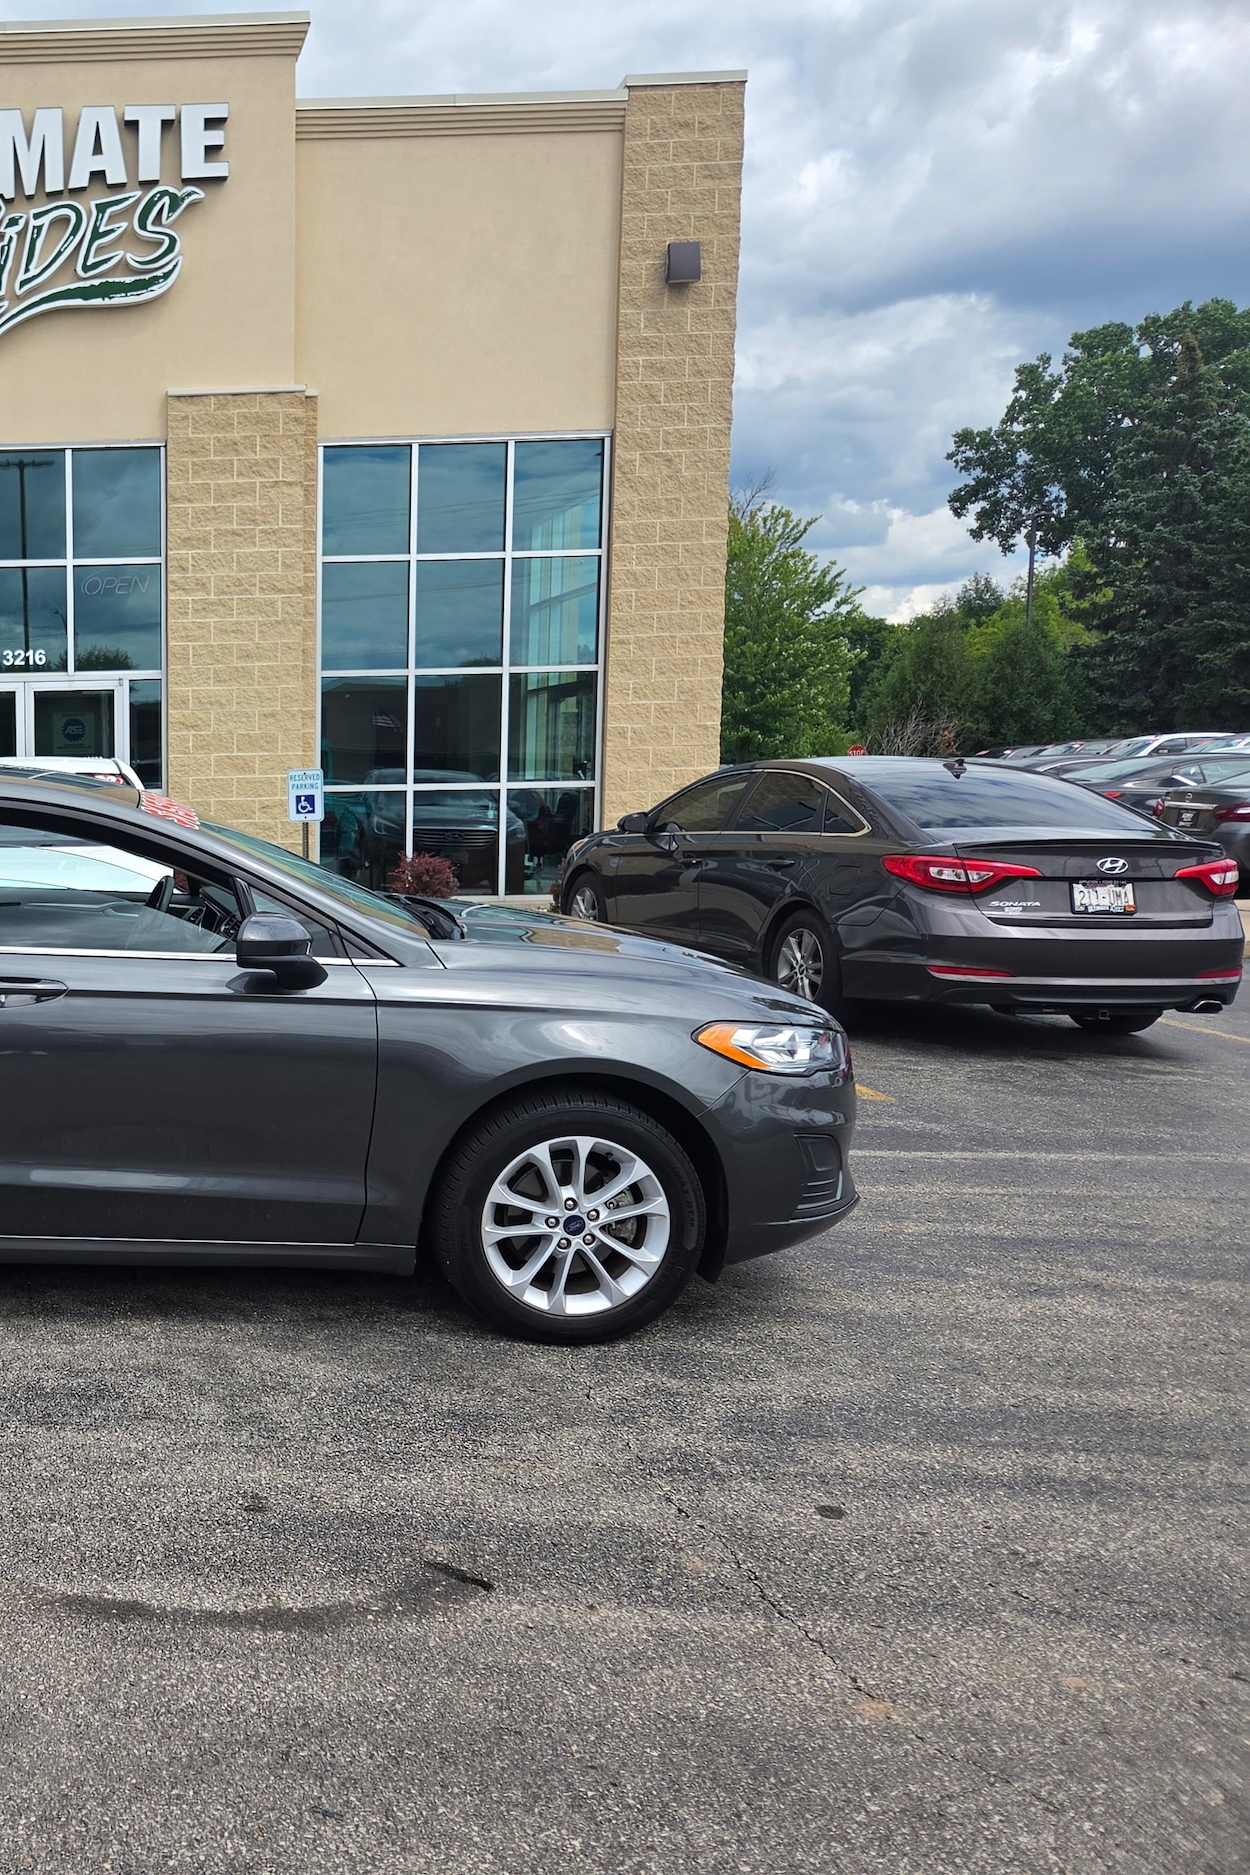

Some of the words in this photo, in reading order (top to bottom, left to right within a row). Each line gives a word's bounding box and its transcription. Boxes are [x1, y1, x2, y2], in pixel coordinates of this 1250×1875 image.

[84, 575, 150, 596] OPEN
[2, 649, 47, 667] 3216
[64, 724, 84, 735] ASE
